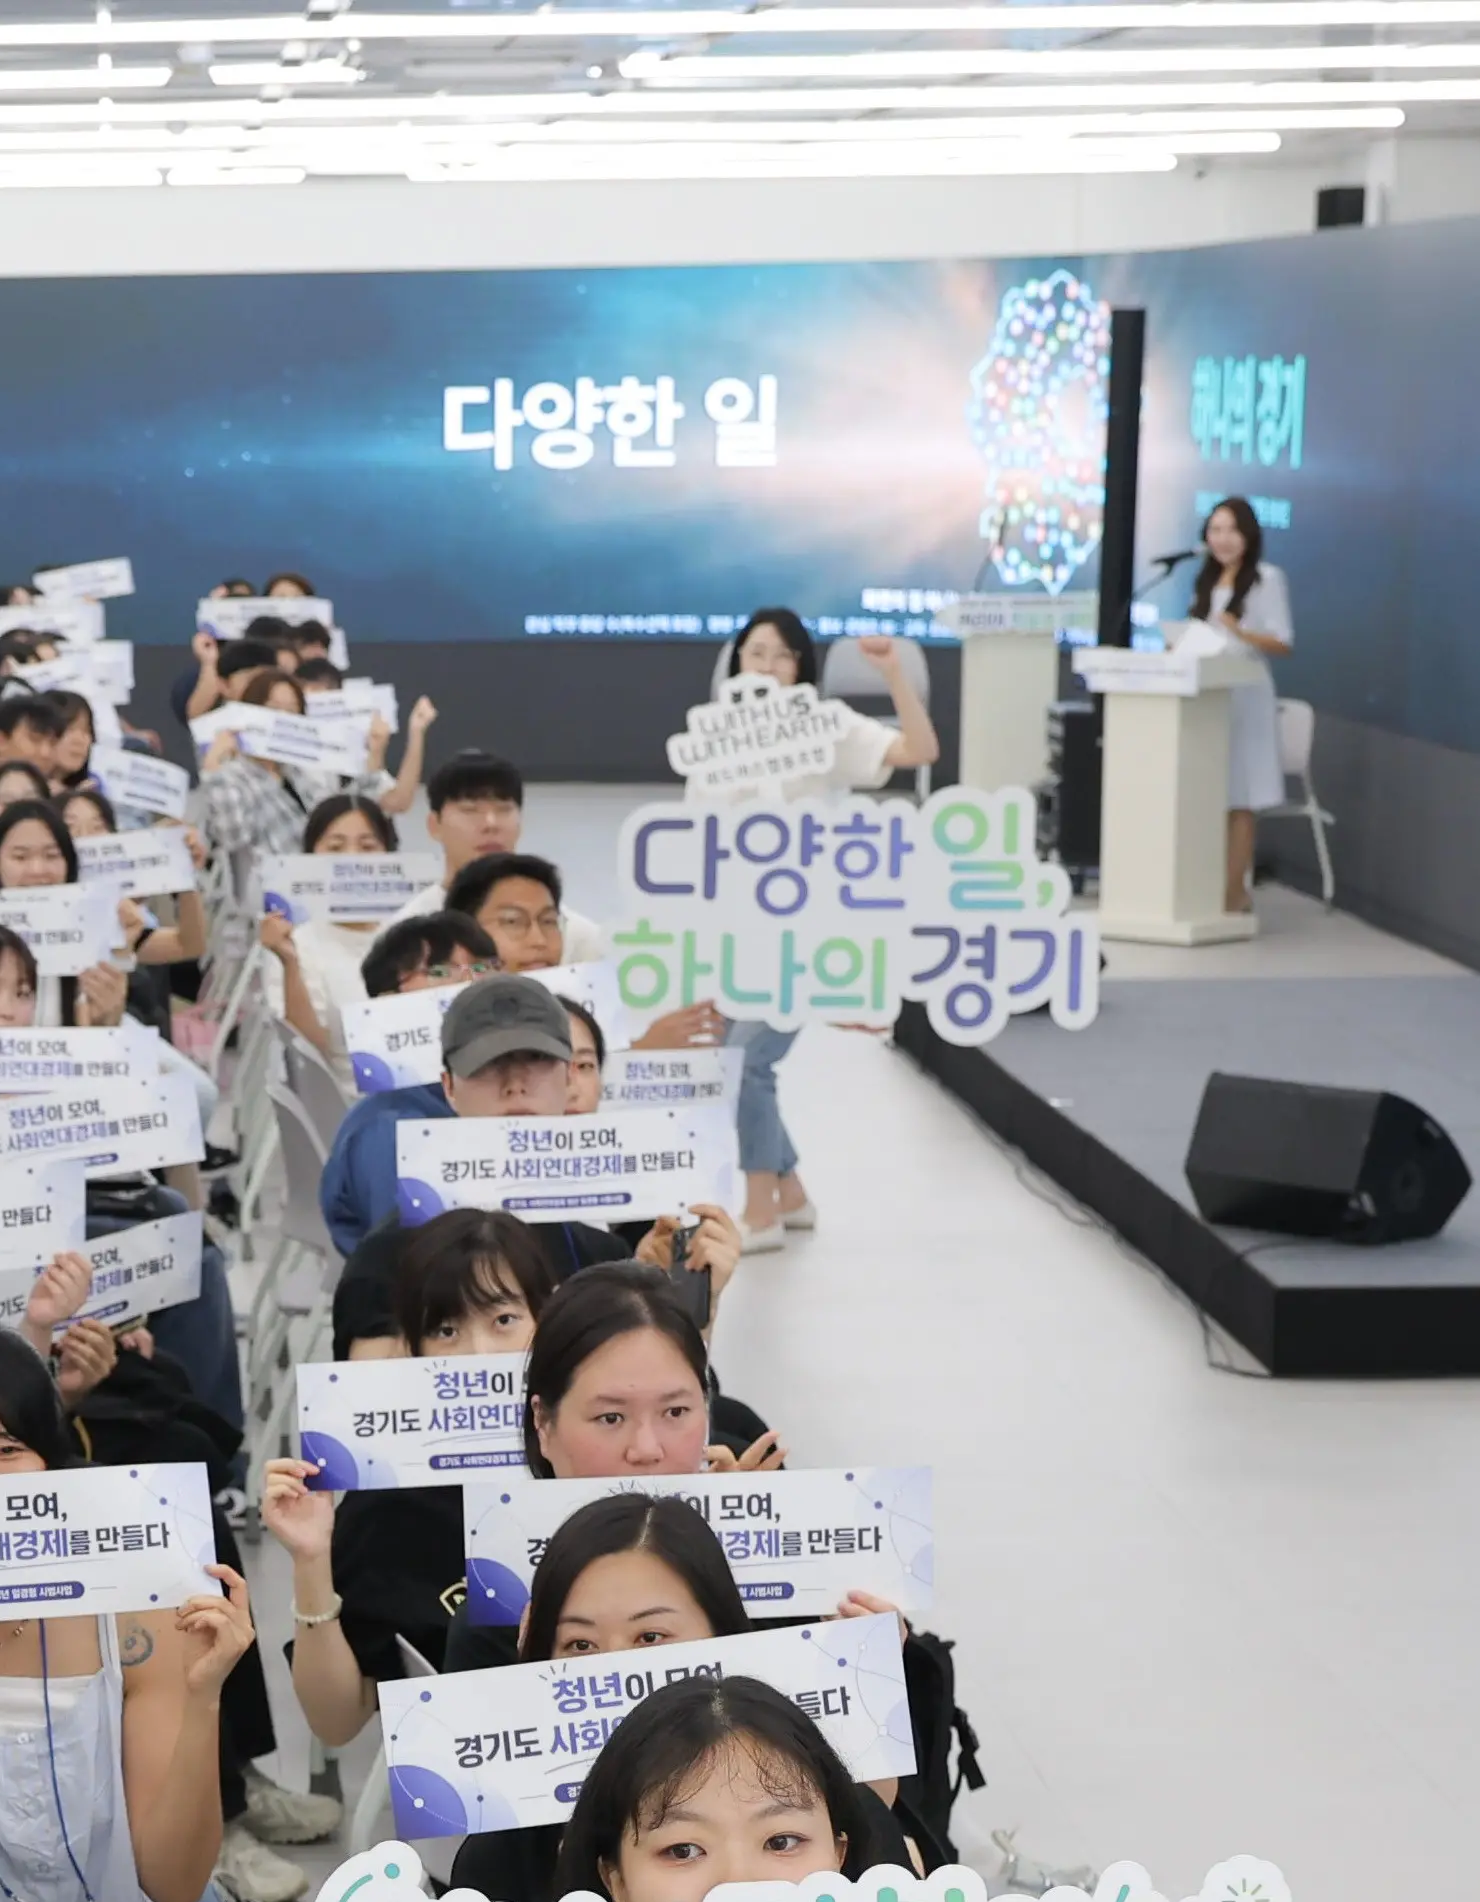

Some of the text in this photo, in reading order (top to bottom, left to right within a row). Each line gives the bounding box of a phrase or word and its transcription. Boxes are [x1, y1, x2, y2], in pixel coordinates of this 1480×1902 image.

[443, 374, 778, 470] 다양한 일
[633, 802, 1055, 917] 다양한 일,
[613, 919, 1082, 1029] 하나의 경기
[6, 1111, 168, 1151] 사회연대경제를 만들다
[8, 1104, 64, 1129] 청년이
[507, 1127, 622, 1153] 청년이 모여,
[441, 1150, 695, 1181] 경기도 사회연대경제를 만들다
[2, 1205, 52, 1227] 만들다
[434, 1370, 514, 1400] 청년이
[354, 1409, 422, 1437] 경기도
[6, 1492, 67, 1522] 모여,
[720, 1493, 780, 1523] 모여,
[96, 1523, 170, 1552] 만들다
[808, 1527, 882, 1554] 만들다
[12, 1588, 36, 1599] 일경험
[40, 1586, 72, 1597] 시범사업
[553, 1670, 656, 1714] 청년이
[455, 1727, 542, 1768] 경기도
